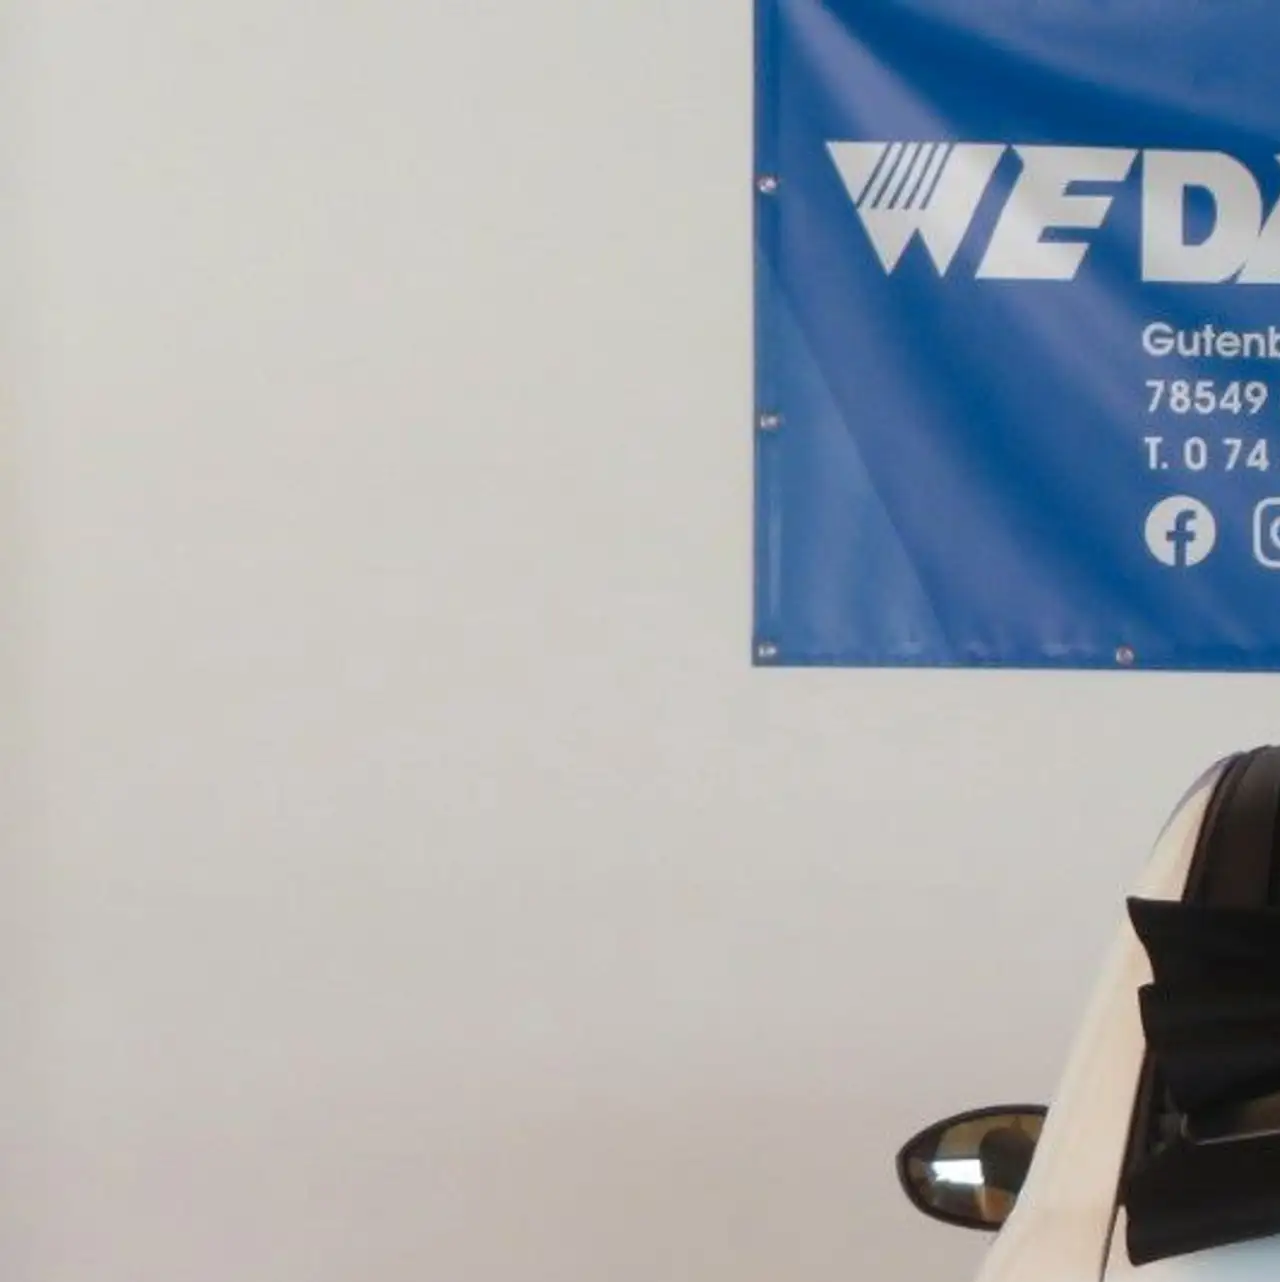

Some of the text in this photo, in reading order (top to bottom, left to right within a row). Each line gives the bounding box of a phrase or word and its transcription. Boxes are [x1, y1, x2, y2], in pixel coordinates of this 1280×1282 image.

[1145, 380, 1268, 414] 78549
[1144, 436, 1168, 470] T.
[1184, 437, 1206, 470] 0
[1223, 438, 1269, 471] 74
